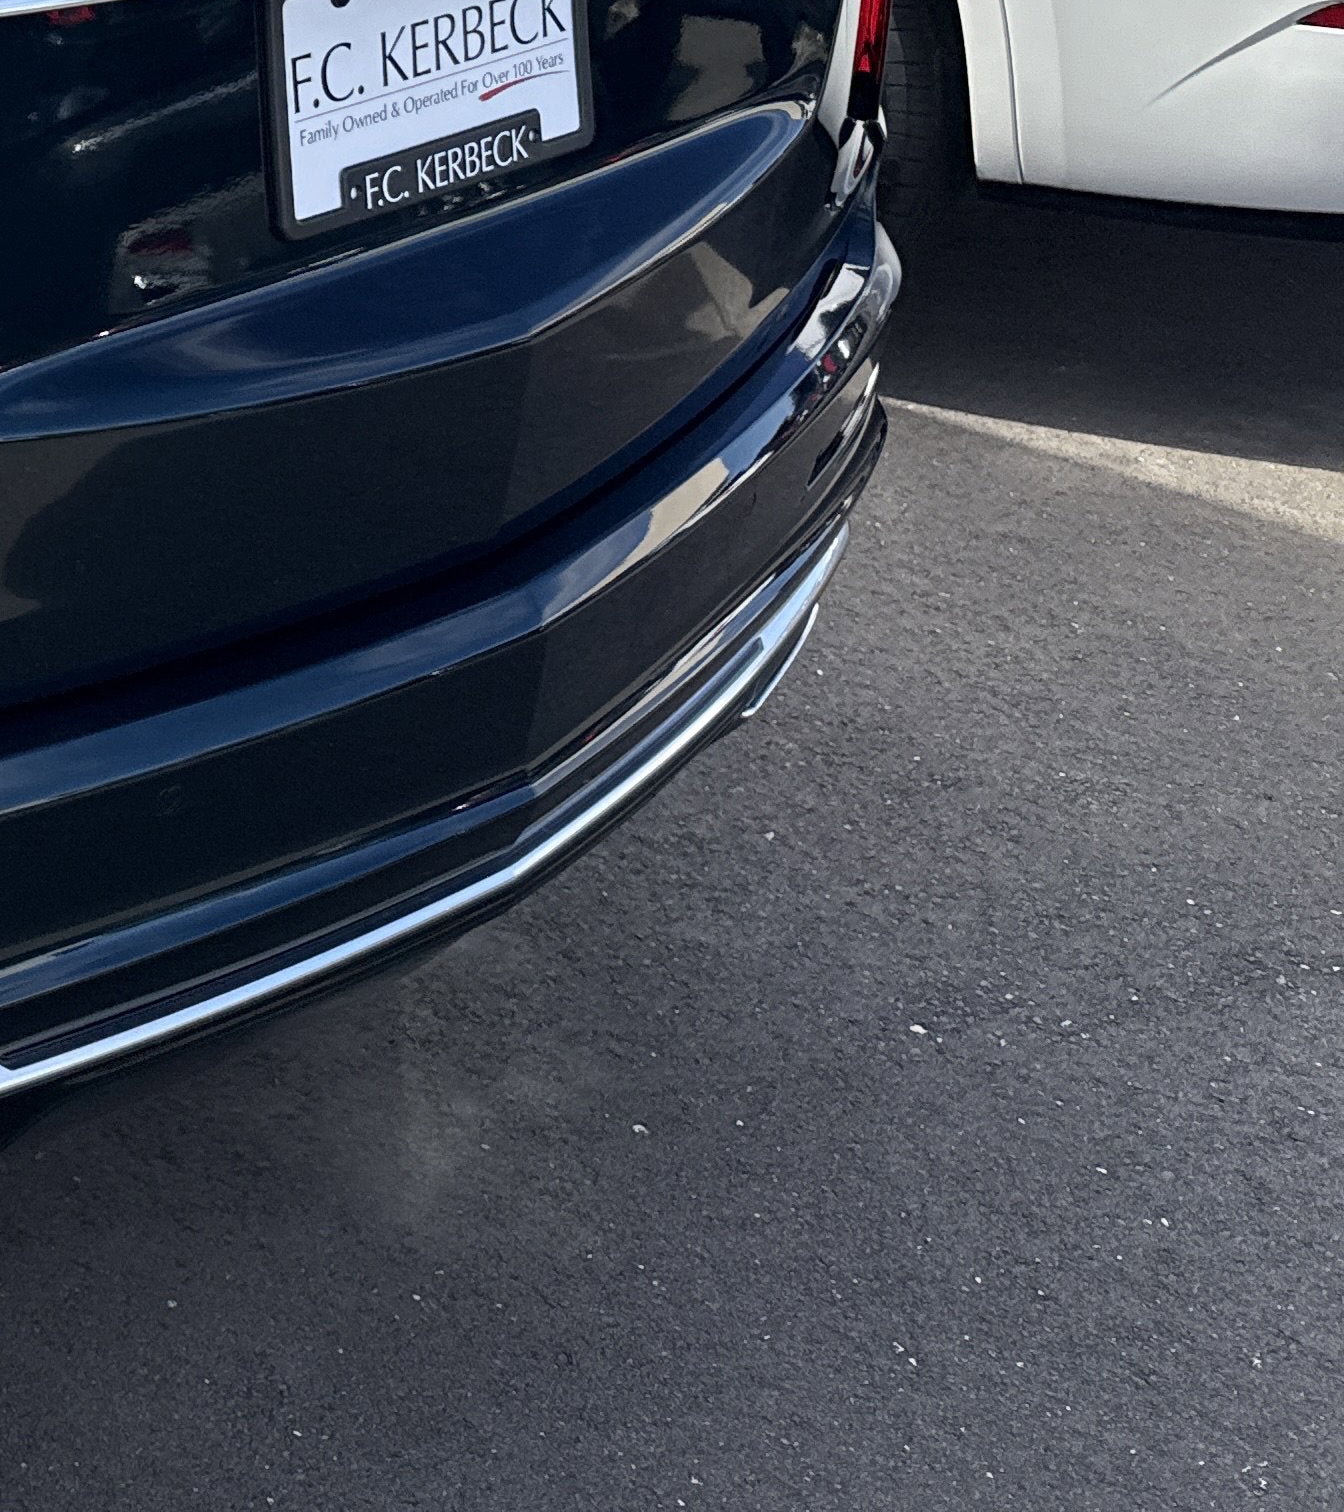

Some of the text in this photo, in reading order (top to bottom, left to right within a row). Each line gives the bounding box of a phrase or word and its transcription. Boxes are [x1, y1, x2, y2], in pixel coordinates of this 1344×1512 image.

[291, 41, 365, 115] F.C.
[299, 52, 564, 147] Family Owned & Operated For Over 100 Years
[365, 124, 529, 210] F.C. KERBECK
